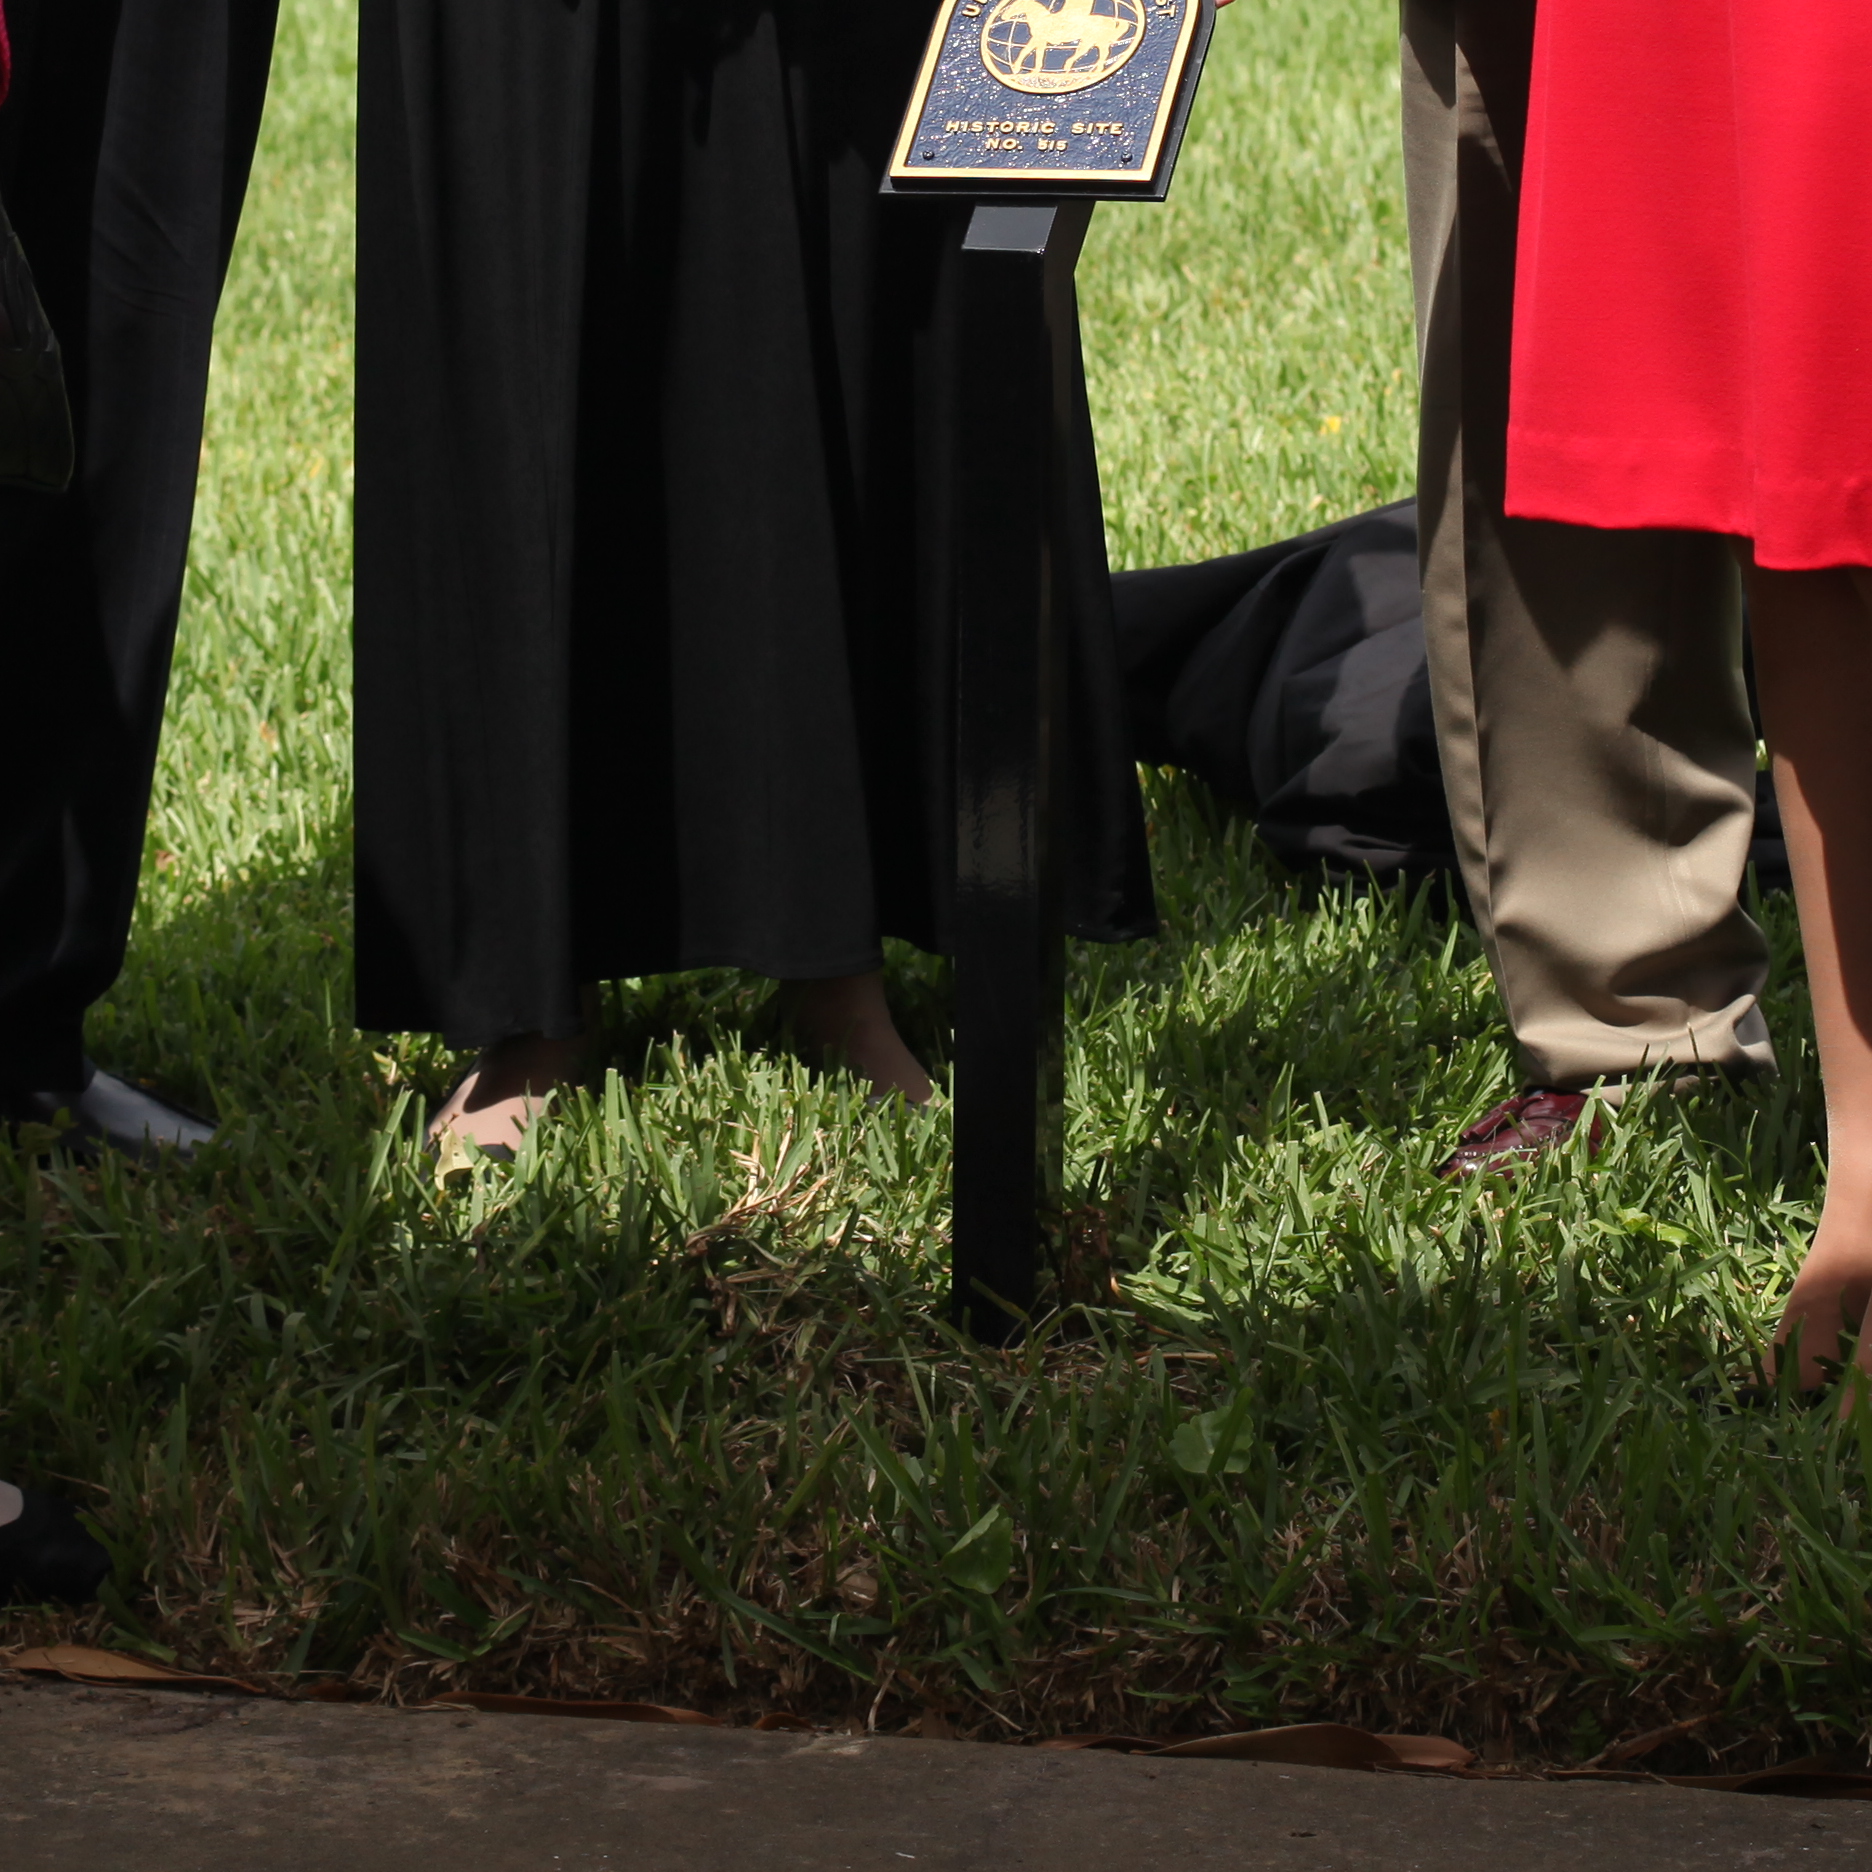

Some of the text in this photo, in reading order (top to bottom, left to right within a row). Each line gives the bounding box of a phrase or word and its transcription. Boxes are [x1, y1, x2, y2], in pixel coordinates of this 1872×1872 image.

[945, 120, 1125, 135] HISTORIC SITE
[985, 137, 1068, 152] NO. 515
